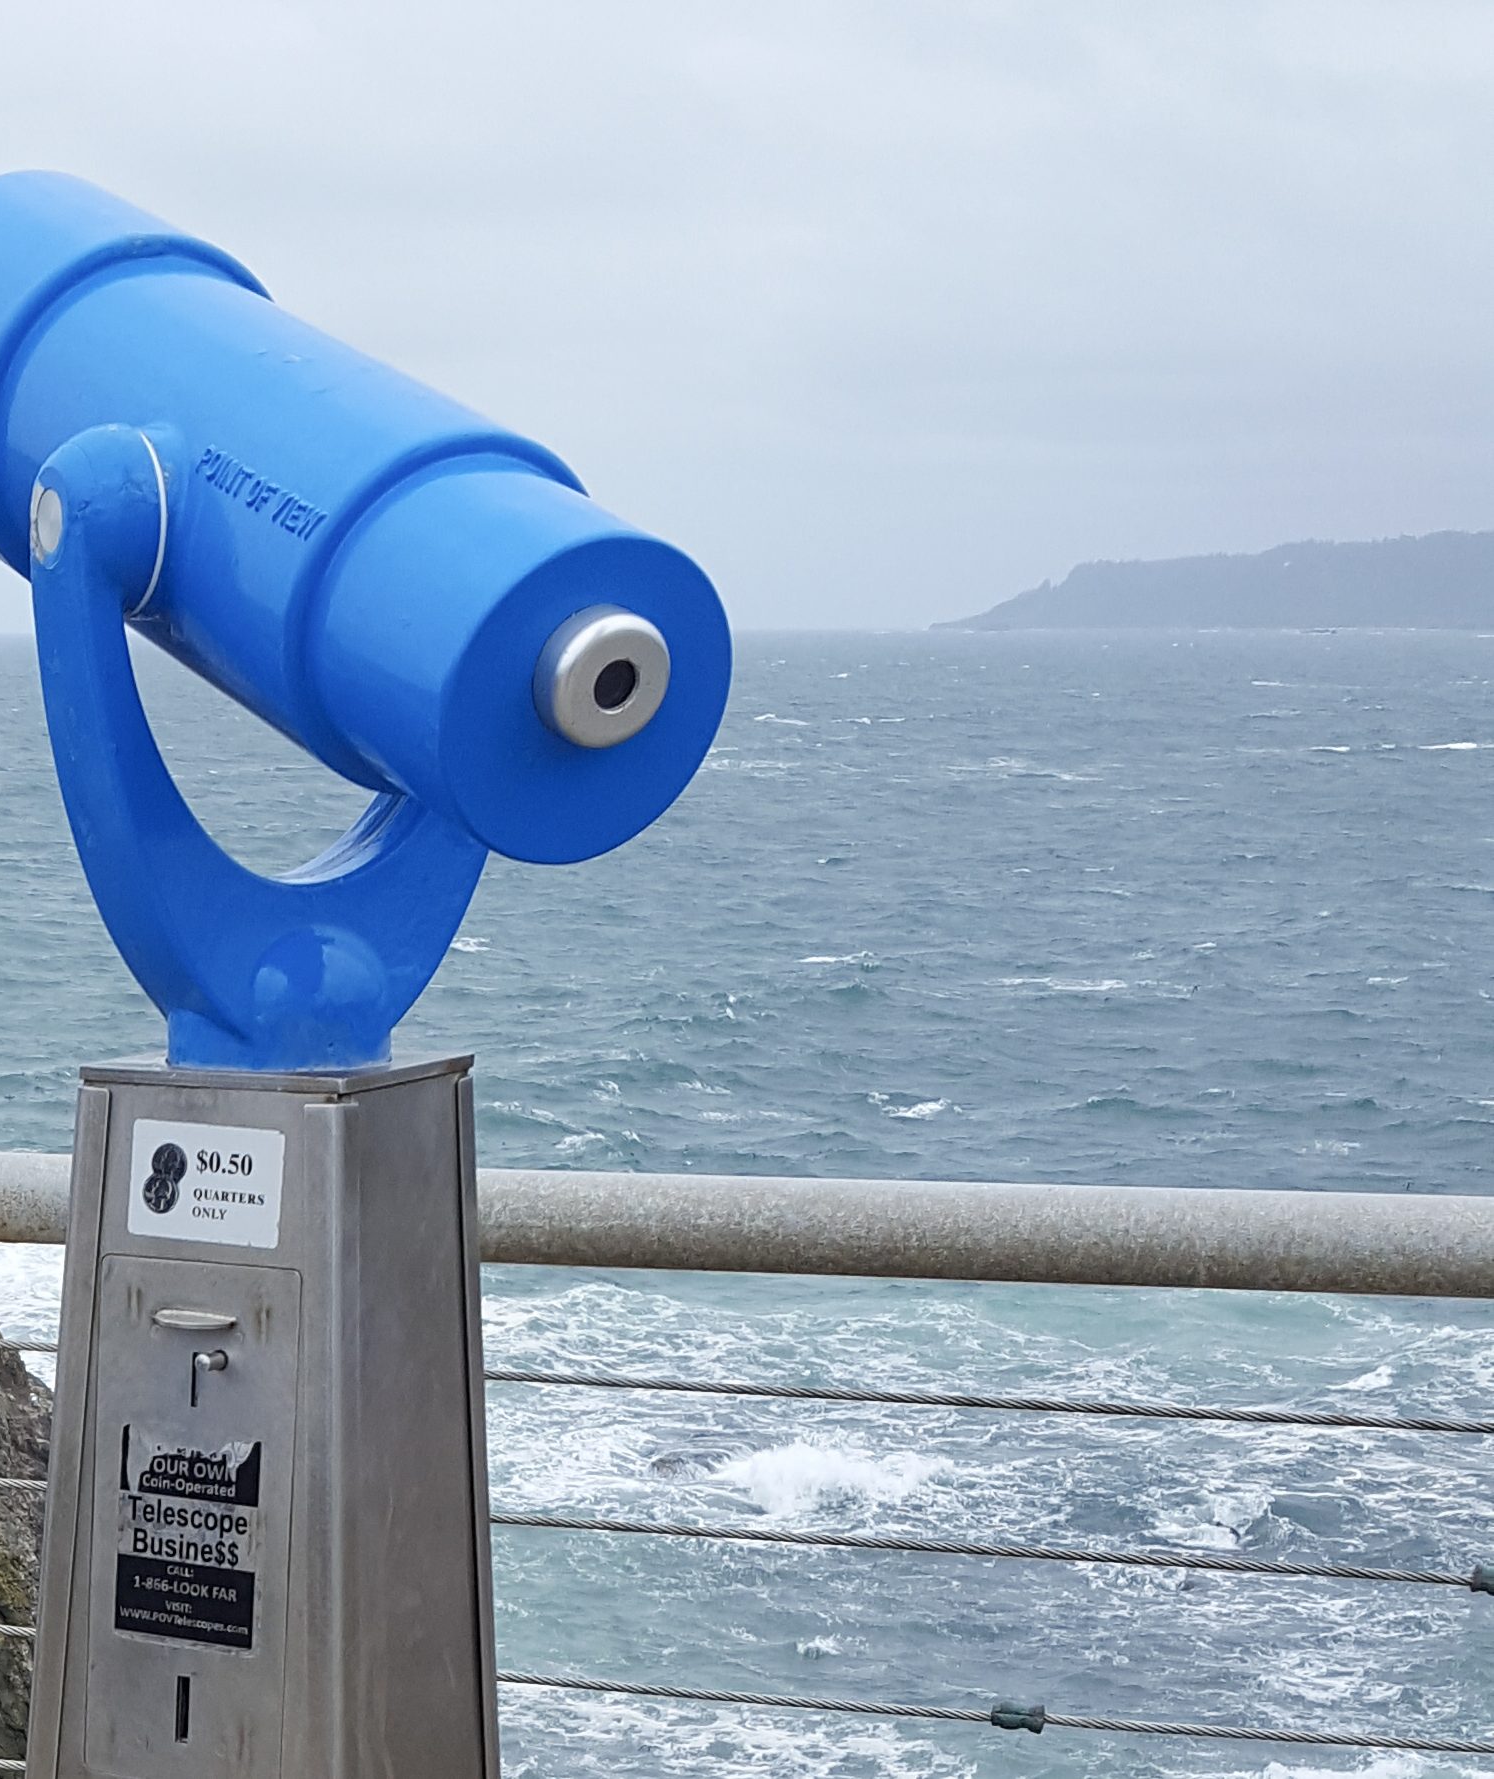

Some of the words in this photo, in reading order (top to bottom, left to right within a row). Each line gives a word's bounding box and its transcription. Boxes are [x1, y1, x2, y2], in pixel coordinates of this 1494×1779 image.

[195, 446, 254, 498] POINT
[246, 477, 279, 512] OF
[272, 491, 327, 541] VIEW
[196, 1149, 253, 1176] $0.50
[193, 1188, 266, 1206] QUARTERS
[192, 1205, 228, 1221] ONLY
[153, 1457, 189, 1477] OUR
[142, 1473, 236, 1498] Coin-Operated
[128, 1496, 248, 1538] Telescope
[133, 1527, 239, 1568] Busine$$
[166, 1565, 194, 1578] CALL:
[133, 1575, 209, 1599] 1-866-LOOK
[212, 1586, 238, 1602] FAR
[165, 1600, 193, 1614] VISIT:
